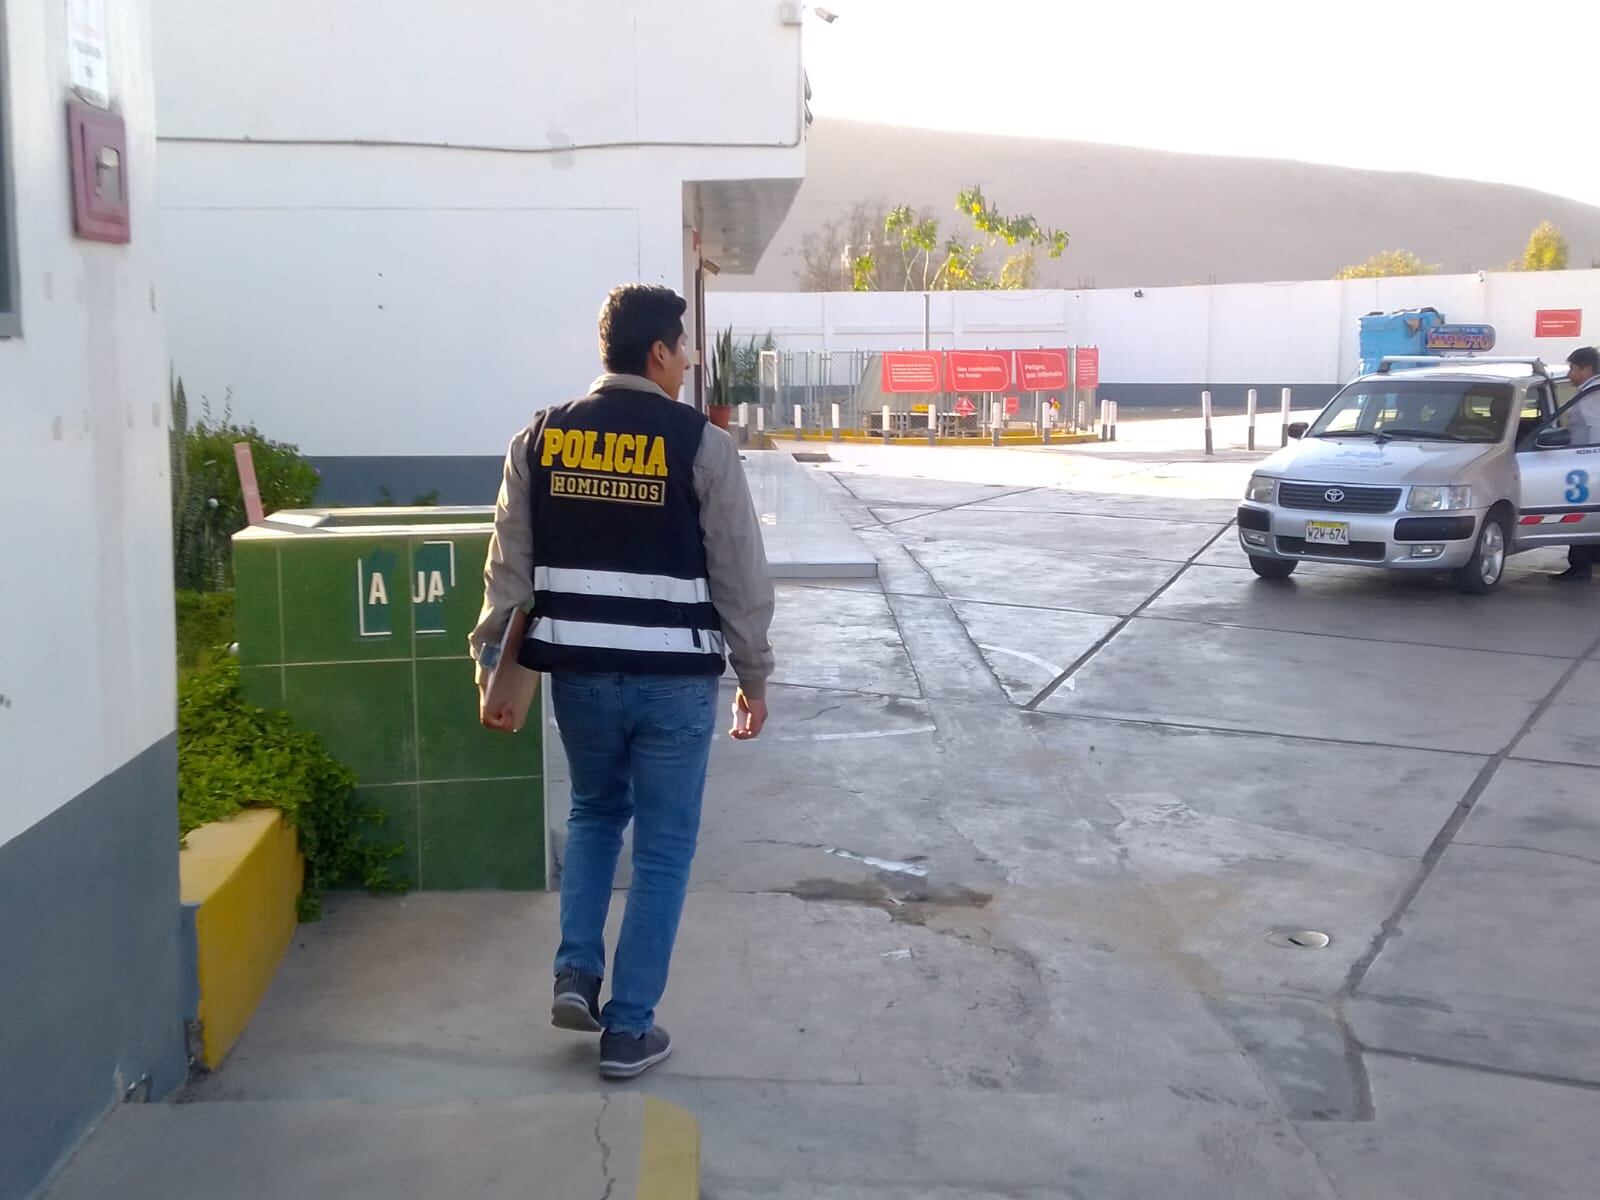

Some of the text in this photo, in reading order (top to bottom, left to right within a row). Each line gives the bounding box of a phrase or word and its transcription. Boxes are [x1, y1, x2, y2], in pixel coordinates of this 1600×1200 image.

[541, 428, 668, 476] POLICIA
[553, 475, 660, 501] HOMICIDIOS
[1565, 469, 1589, 504] 3
[1307, 527, 1347, 541] W2W-674
